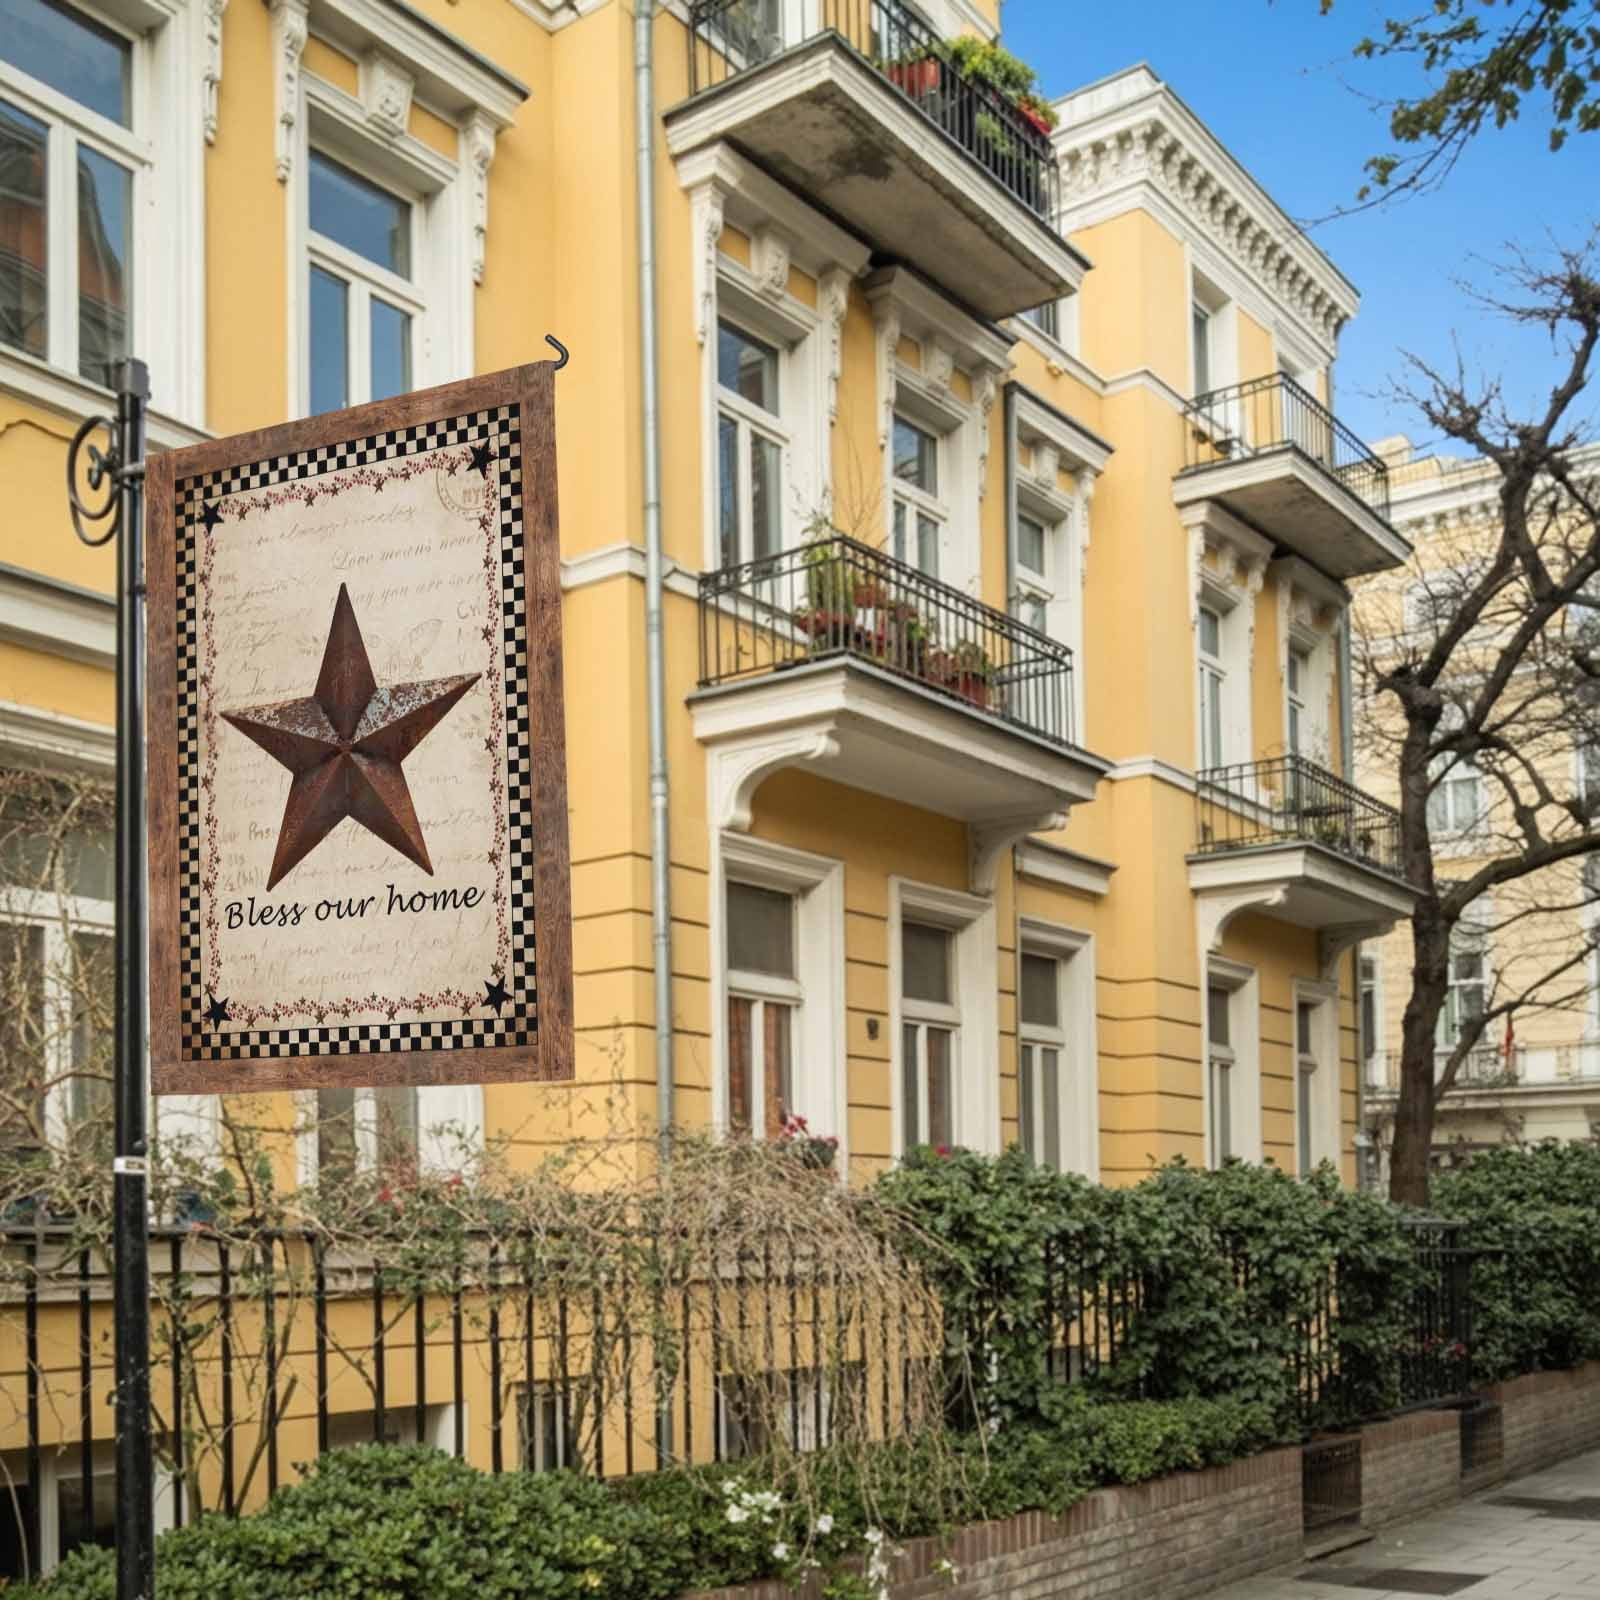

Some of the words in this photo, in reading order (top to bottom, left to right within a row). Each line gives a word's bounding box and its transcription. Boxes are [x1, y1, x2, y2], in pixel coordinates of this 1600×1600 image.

[224, 896, 307, 930] Bless
[315, 895, 376, 921] our
[386, 883, 486, 916] home
